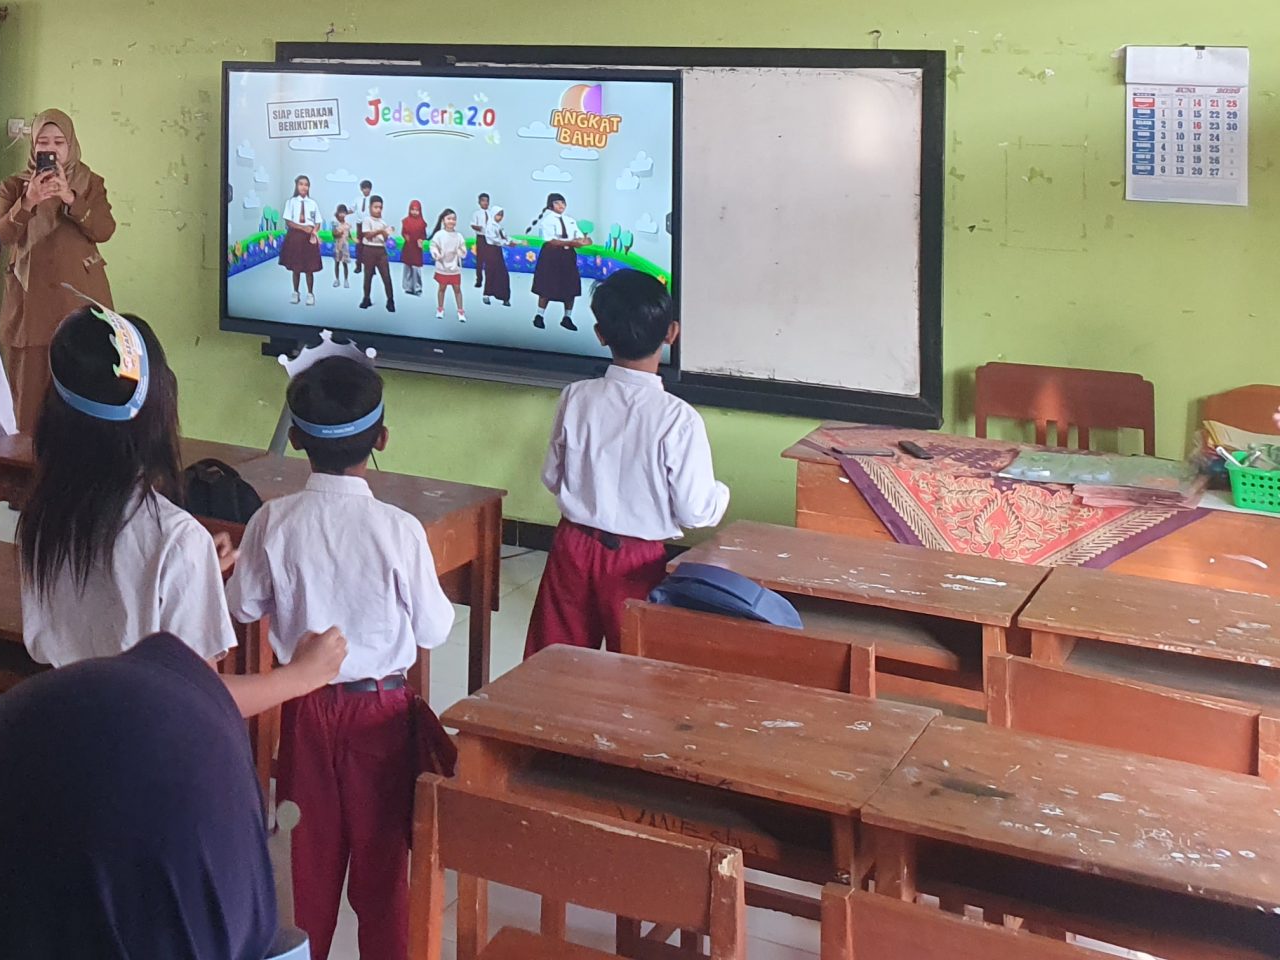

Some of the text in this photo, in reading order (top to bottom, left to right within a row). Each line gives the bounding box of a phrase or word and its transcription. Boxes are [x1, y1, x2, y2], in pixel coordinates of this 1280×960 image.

[1210, 100, 1219, 108] 21
[272, 107, 334, 120] SIAP GERAKAN
[364, 98, 496, 127] Jeda Ceria 2.0
[1194, 110, 1202, 118] 15
[278, 119, 330, 132] BERIKUTNYA
[553, 111, 621, 133] ANGKAT
[1193, 122, 1202, 130] 16
[1209, 122, 1220, 130] 23
[560, 128, 606, 147] BAHU
[1176, 132, 1184, 140] 10
[1209, 134, 1220, 142] 24
[1177, 144, 1184, 152] 11
[1193, 156, 1202, 164] 19
[1209, 156, 1220, 164] 26
[1192, 168, 1203, 176] 20
[1209, 168, 1220, 176] 27
